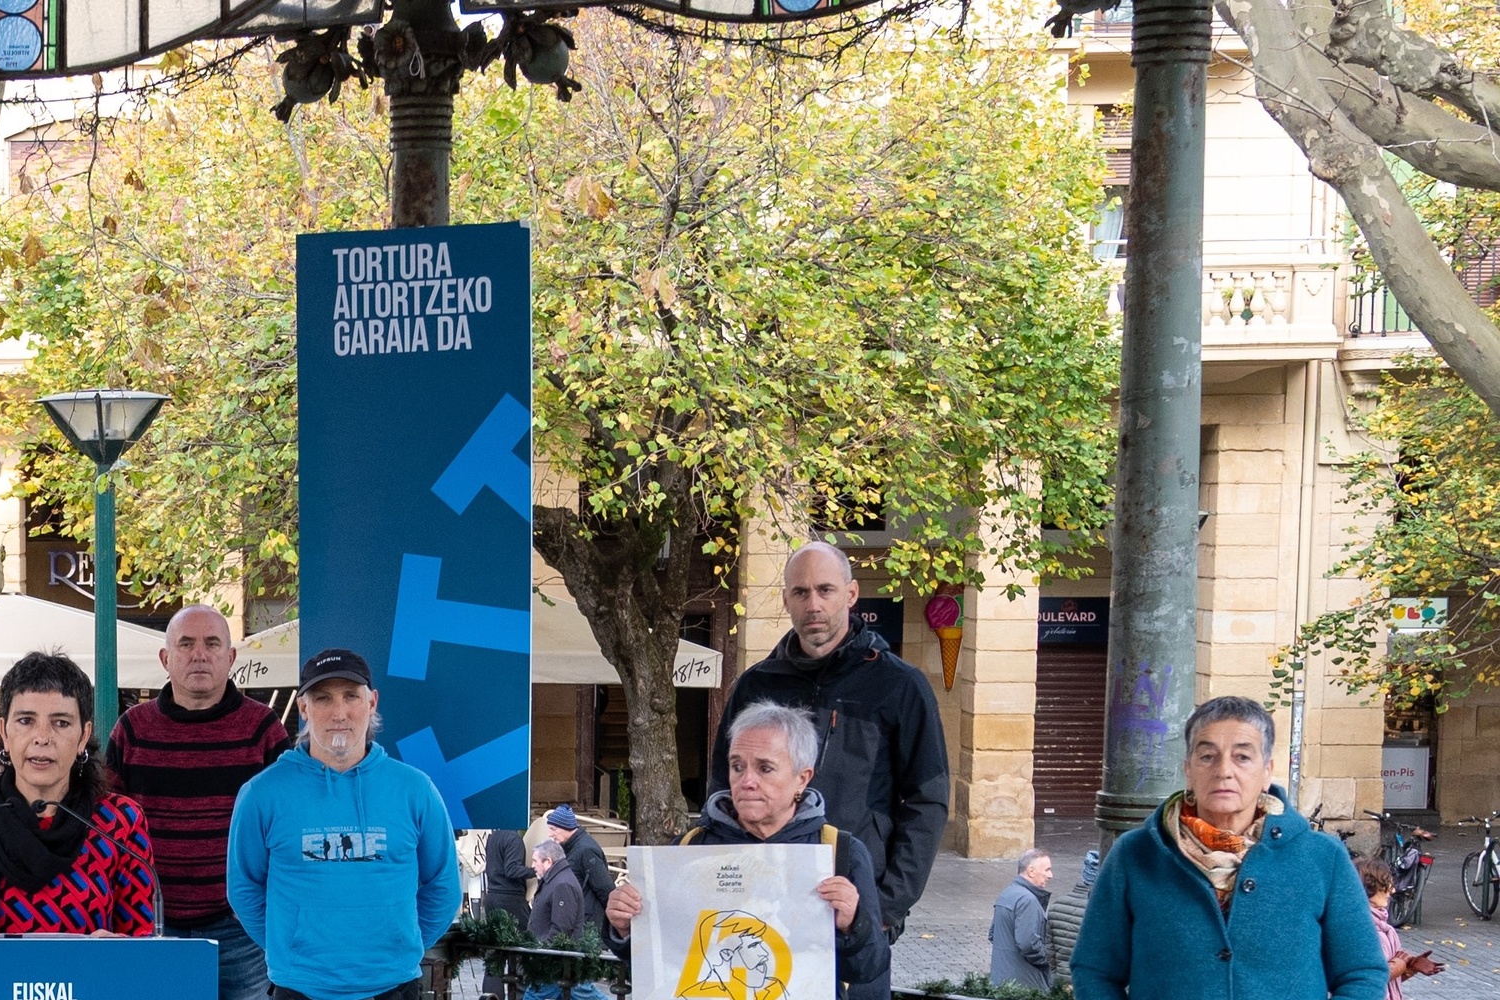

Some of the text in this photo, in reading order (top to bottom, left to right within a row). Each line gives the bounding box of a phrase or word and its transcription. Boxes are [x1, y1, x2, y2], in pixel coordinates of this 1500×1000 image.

[333, 242, 452, 283] TORTURA
[333, 276, 492, 320] AITORTZEKO
[334, 315, 472, 356] GARAIA DA
[1038, 612, 1096, 622] ULEVARD
[673, 658, 710, 683] 18/70
[1381, 768, 1414, 777] en-Pis
